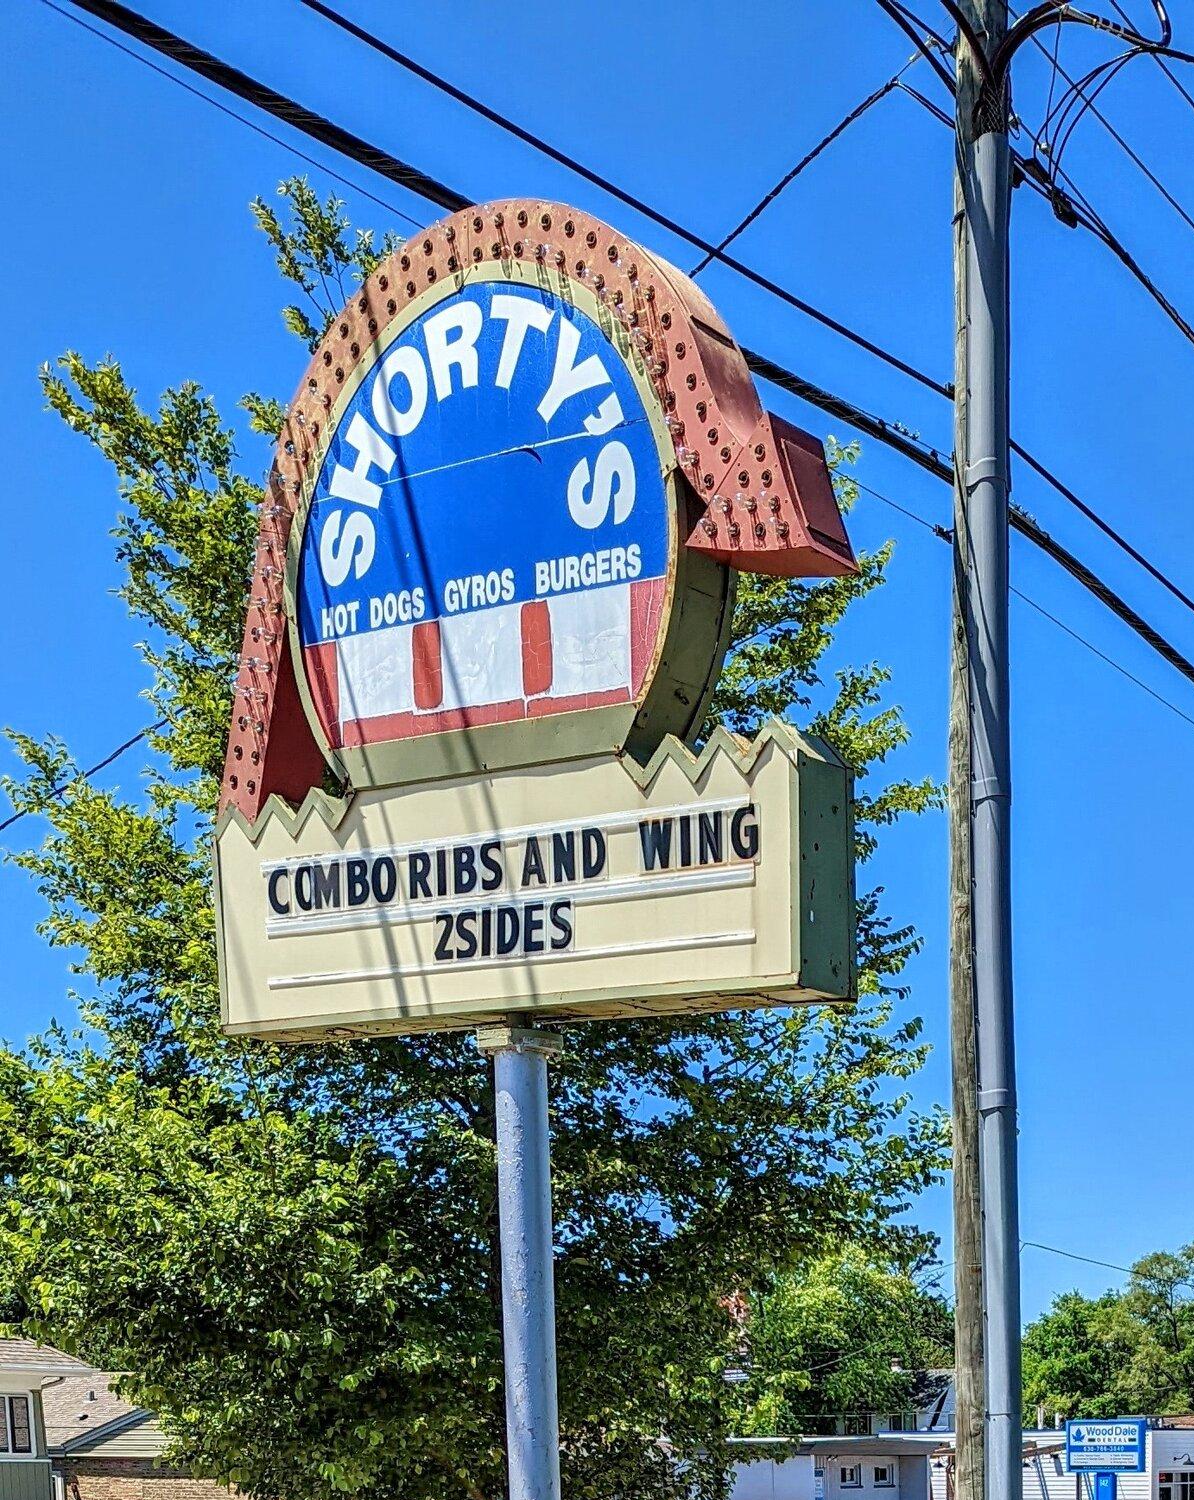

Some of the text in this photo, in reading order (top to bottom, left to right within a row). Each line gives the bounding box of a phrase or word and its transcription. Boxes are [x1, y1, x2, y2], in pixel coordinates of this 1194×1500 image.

[320, 294, 637, 587] SHORTY'S
[321, 543, 642, 639] HOT DOGS GYROS BURGERS
[267, 804, 760, 915] COMBO RIBS AND WING
[434, 900, 572, 960] 2SIDES
